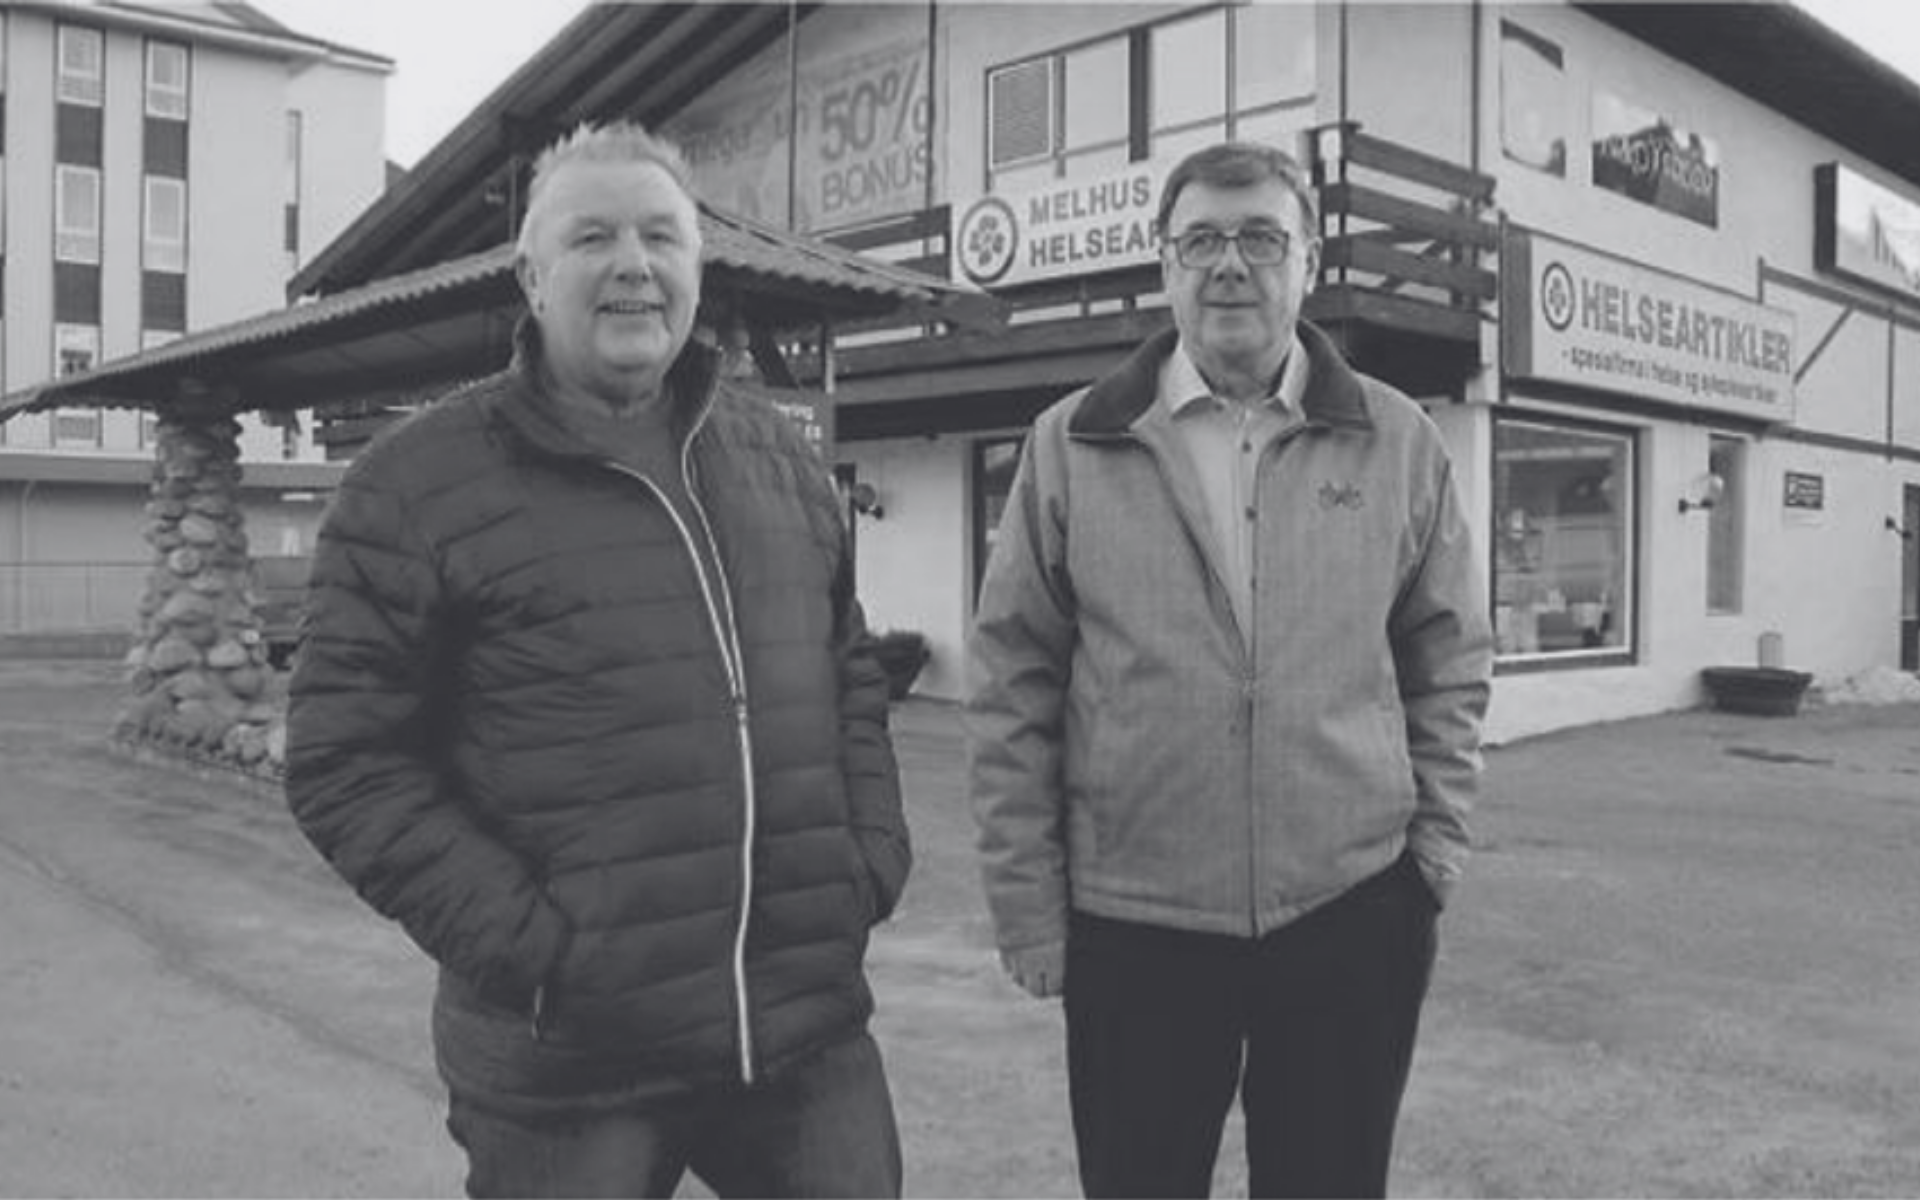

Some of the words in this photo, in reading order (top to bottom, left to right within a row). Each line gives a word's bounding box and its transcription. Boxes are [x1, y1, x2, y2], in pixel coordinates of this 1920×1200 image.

[820, 58, 928, 161] 50%
[820, 140, 930, 212] BONUS
[1028, 175, 1151, 226] MELHUS
[1580, 277, 1791, 375] HELSEARTIKLER
